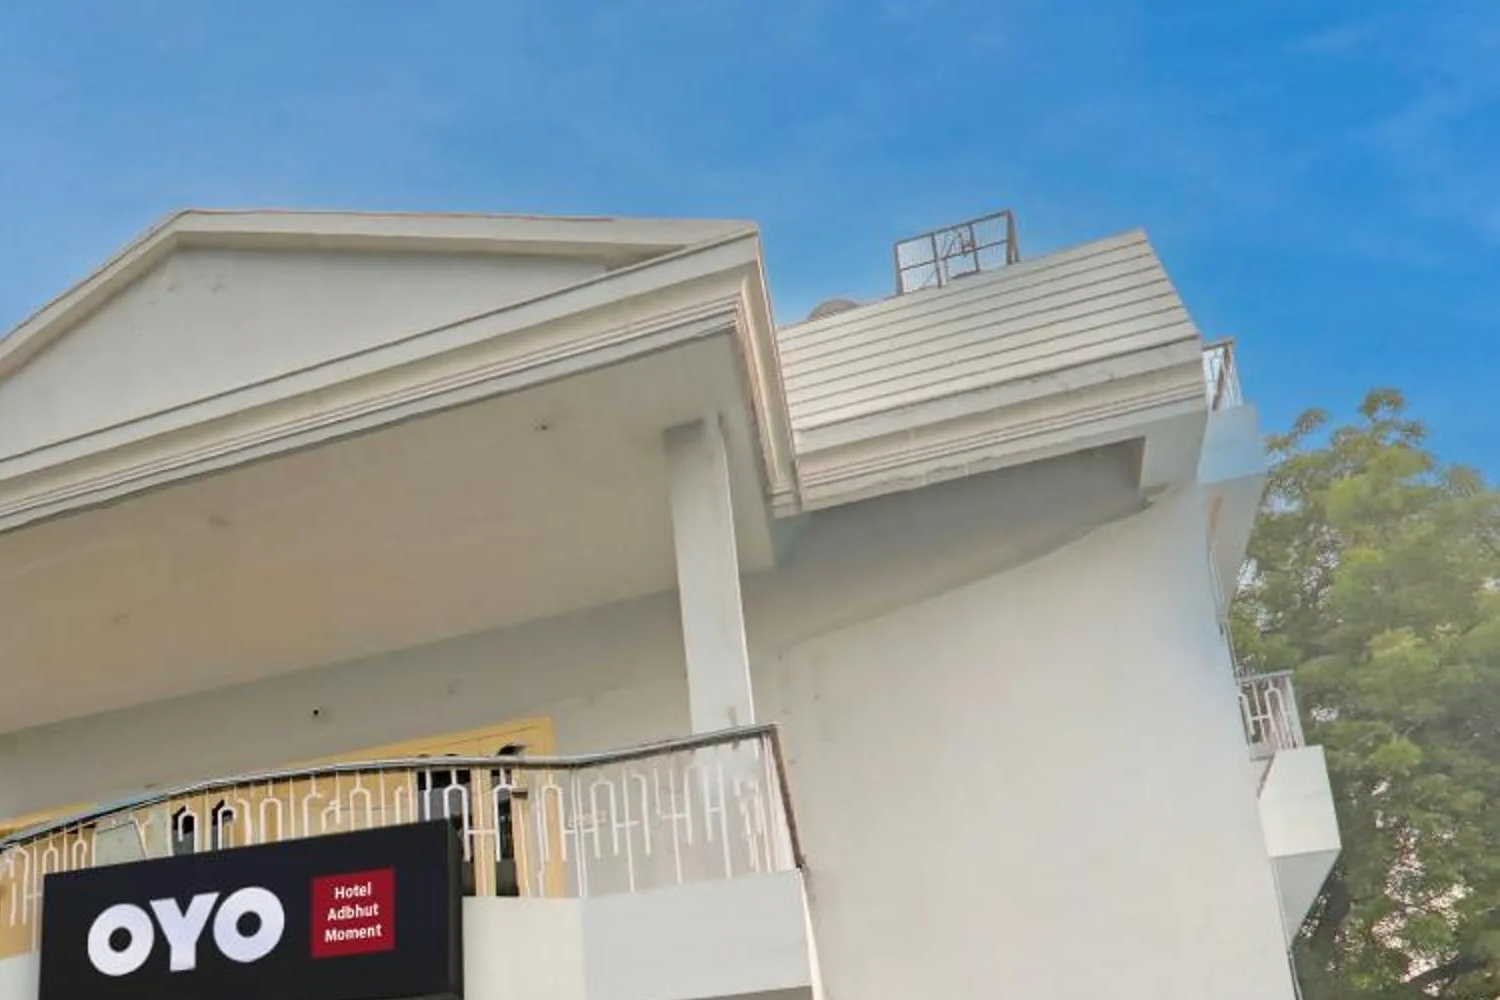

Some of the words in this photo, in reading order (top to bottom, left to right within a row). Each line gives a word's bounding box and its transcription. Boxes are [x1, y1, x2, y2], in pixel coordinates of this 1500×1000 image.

[334, 881, 372, 899] Hotel
[327, 903, 379, 921] Adbhut
[87, 886, 285, 976] OYO
[324, 924, 382, 943] Moment
